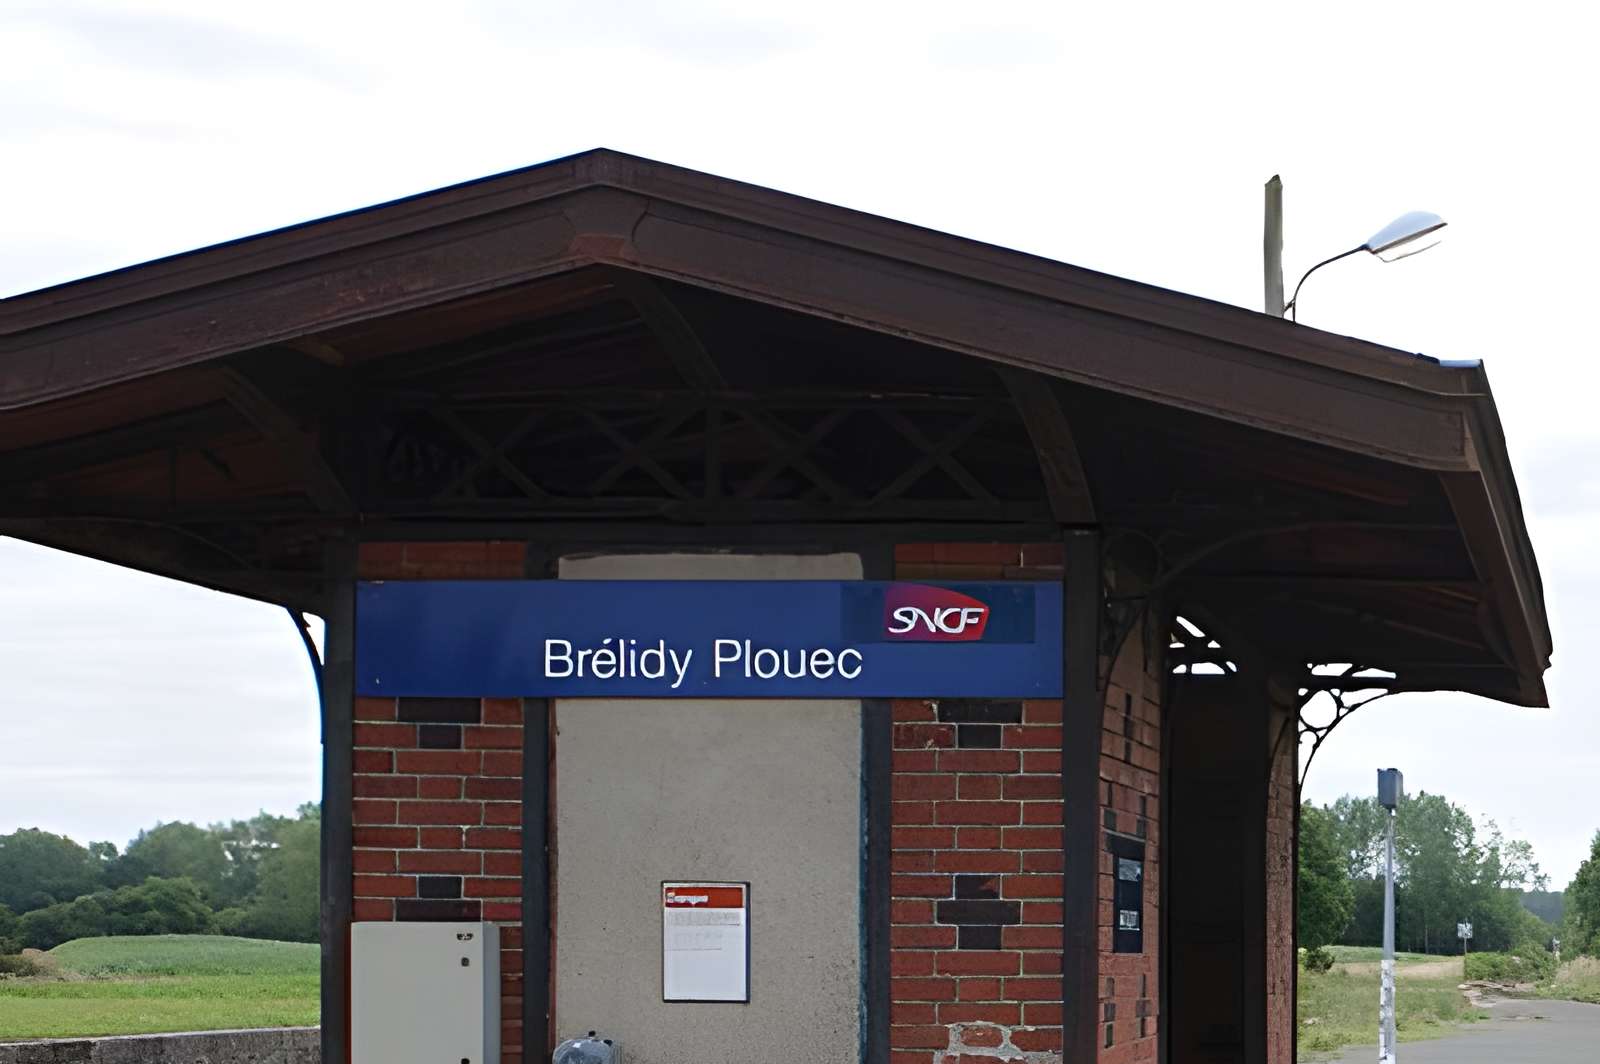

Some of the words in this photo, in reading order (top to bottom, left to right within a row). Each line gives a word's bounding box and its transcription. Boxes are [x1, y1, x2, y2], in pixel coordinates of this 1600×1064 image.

[888, 606, 985, 634] SNCF
[543, 637, 693, 689] Brélidy
[713, 638, 863, 680] Plouec
